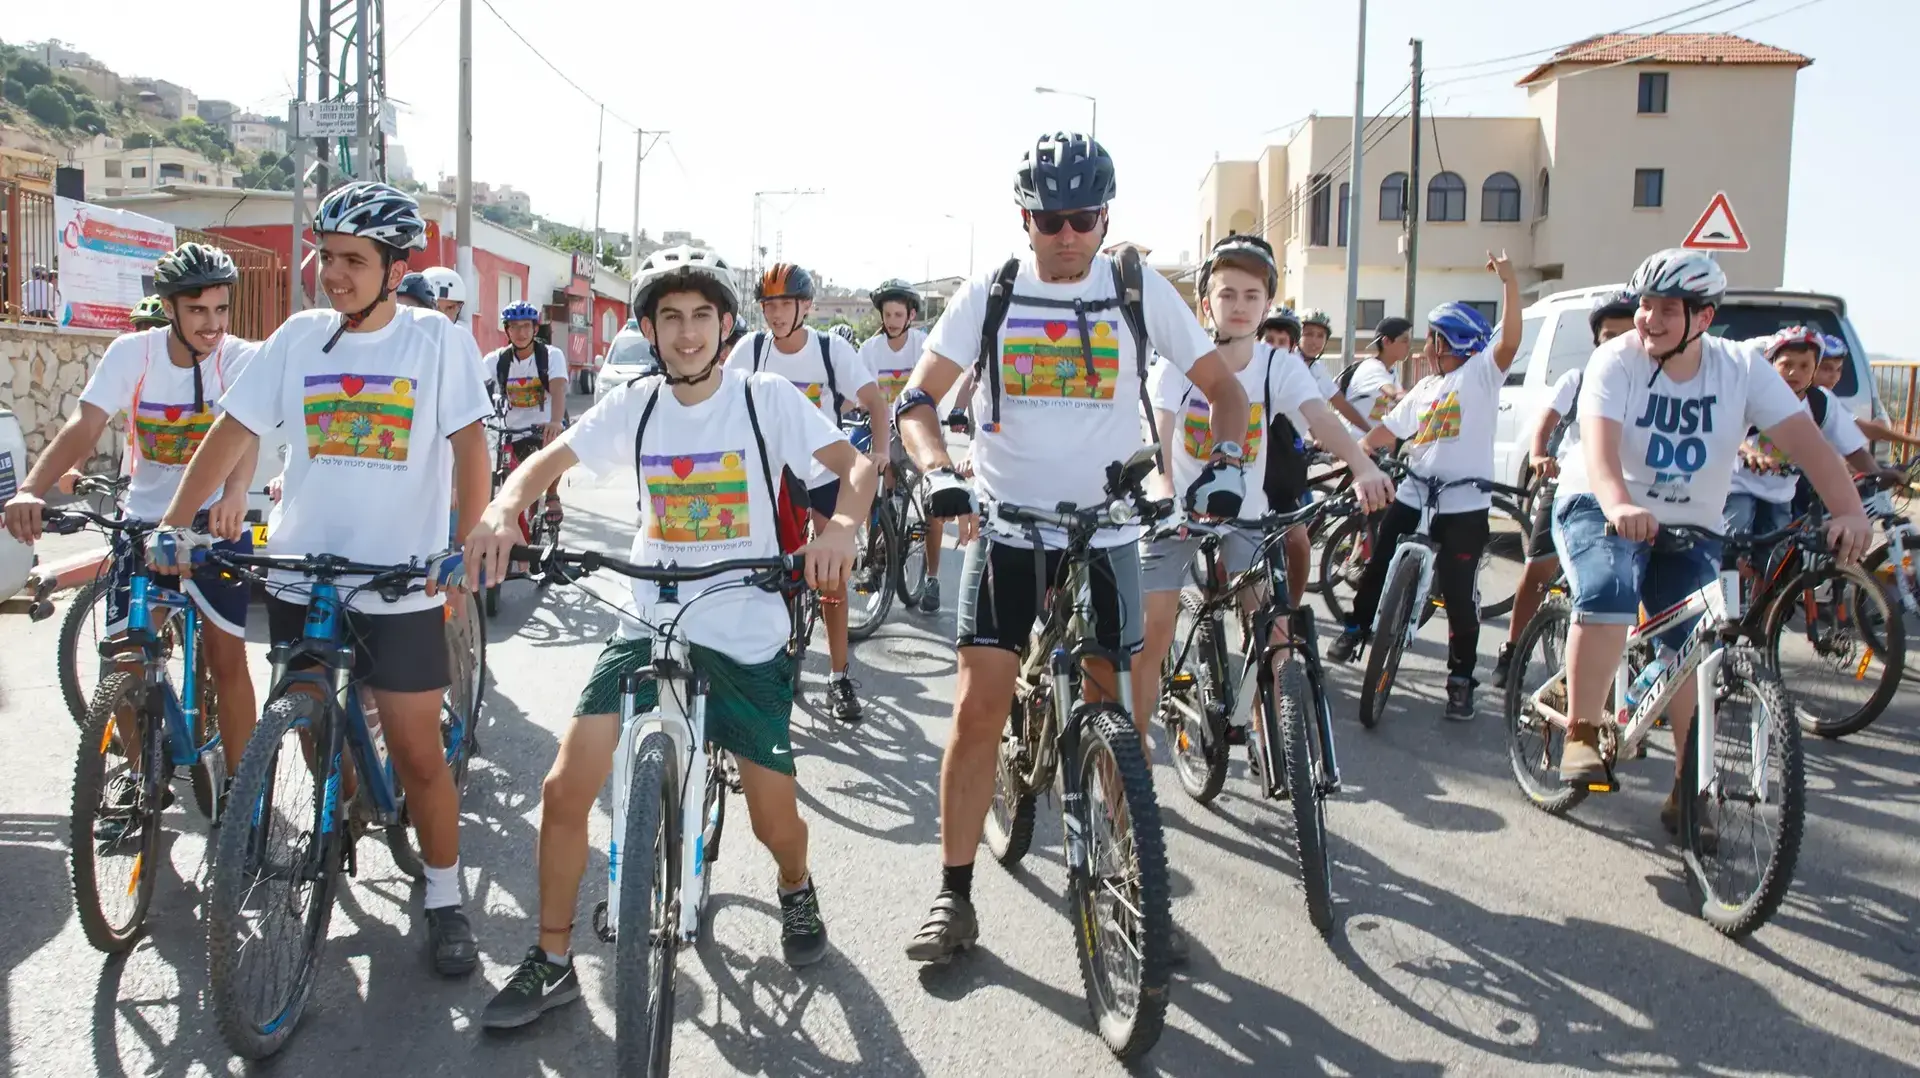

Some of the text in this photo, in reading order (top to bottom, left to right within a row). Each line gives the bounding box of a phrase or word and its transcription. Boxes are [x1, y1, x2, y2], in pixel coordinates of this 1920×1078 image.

[316, 120, 334, 128] Danger
[1635, 394, 1717, 435] JUST
[1645, 432, 1707, 472] DO
[332, 457, 343, 466] של
[344, 458, 366, 469] לזכרה
[367, 461, 392, 471] אופניים
[392, 463, 408, 472] מסע
